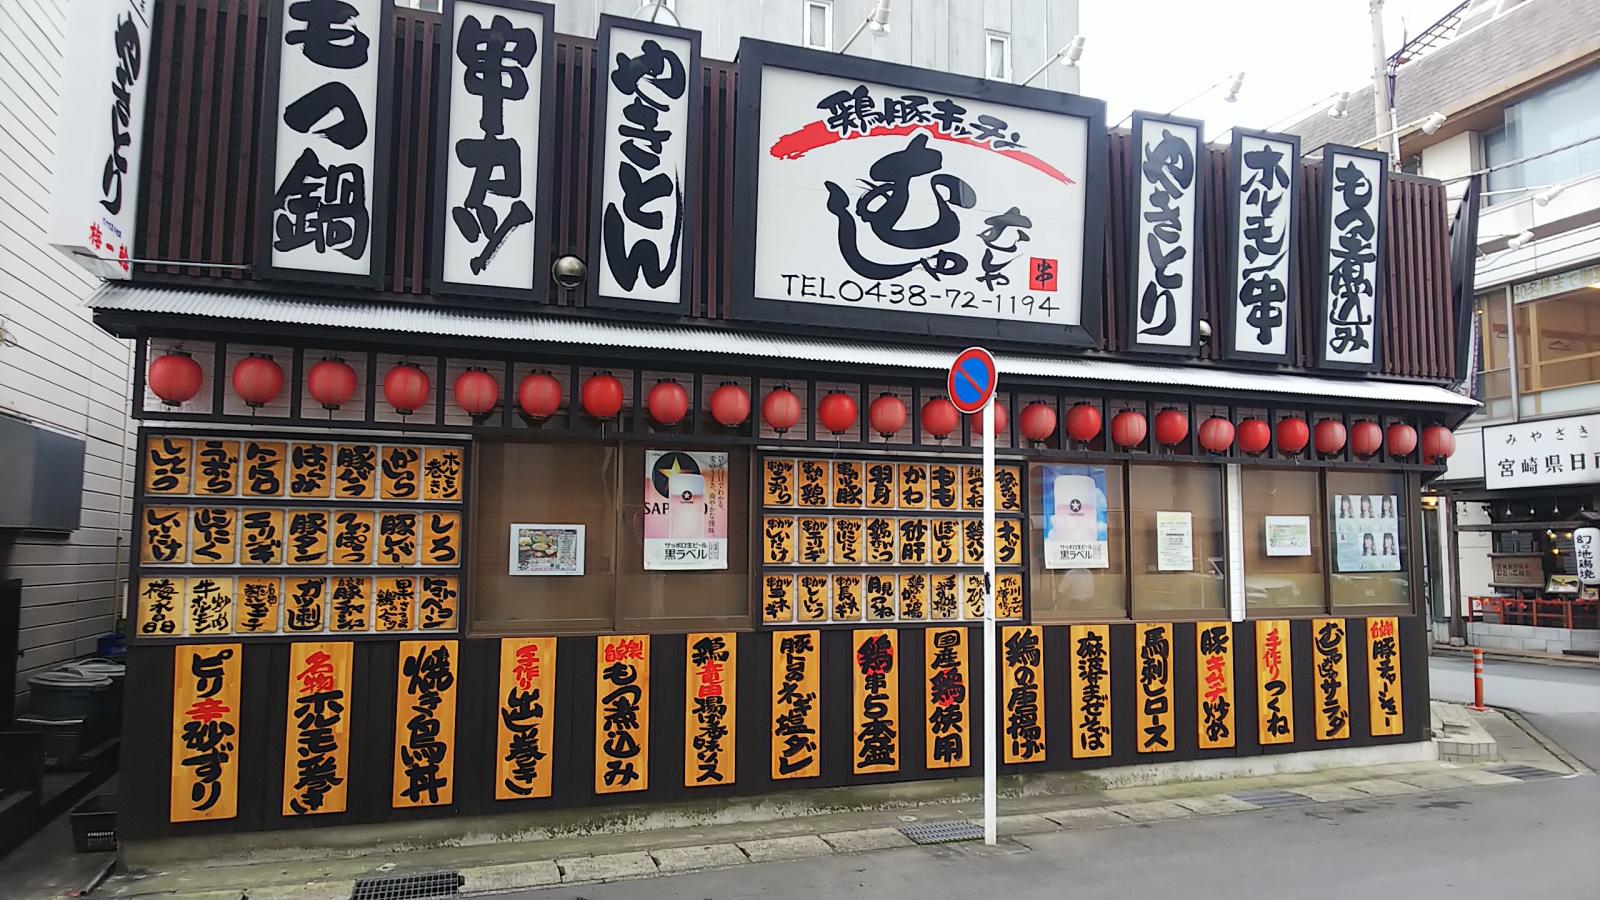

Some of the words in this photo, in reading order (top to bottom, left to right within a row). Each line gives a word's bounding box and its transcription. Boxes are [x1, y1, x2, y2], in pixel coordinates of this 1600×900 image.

[99, 10, 141, 216] やきとり
[273, 0, 370, 260] もつ鍋
[817, 84, 1030, 148] 鶏豚キッチン
[452, 14, 538, 275] 串カツ
[604, 39, 687, 292] やきとん
[824, 133, 977, 281] むしゃ
[1137, 129, 1194, 336] やきとり
[976, 207, 1033, 291] むしゃ
[1239, 145, 1290, 345] ホルモン串
[1329, 161, 1376, 354] もつ煮込み
[1035, 259, 1053, 290] 串
[150, 438, 186, 491] ししとう
[200, 441, 238, 493] うずら
[292, 444, 328, 494] はらみ
[336, 445, 375, 496] 豚バラ
[382, 448, 418, 497] かしら
[902, 465, 926, 505] かわ
[931, 466, 955, 507] もも
[995, 469, 1020, 509] ねぎま
[147, 509, 182, 561] しいたけ
[194, 508, 232, 560] にんにく
[244, 512, 281, 564] エリンギ
[290, 512, 327, 562] 豚タン
[336, 513, 371, 562] てっぽう
[381, 514, 416, 562] 豚レバー
[430, 514, 456, 562] しろ
[665, 549, 707, 560] 黒ラベル
[901, 520, 928, 561] 砂肝
[995, 521, 1020, 562] ネック
[1060, 550, 1093, 560] 黒ラベル
[142, 579, 179, 634] 梅水晶
[287, 576, 327, 630] ガツ刺し
[775, 634, 817, 775] 豚トロのネギ塩ダレ
[929, 630, 966, 763] 国産鶏使用
[1005, 629, 1045, 760] 鶏の唐揚げ
[1077, 631, 1110, 751] 麻婆まぜそば
[1140, 627, 1169, 748] 馬刺しロース
[1200, 626, 1230, 742] 豚キムチ炒め
[1262, 628, 1290, 737] 手作りつくね
[181, 649, 235, 811] ピリ辛砂ずり
[401, 645, 454, 803] 焼き鳥丼
